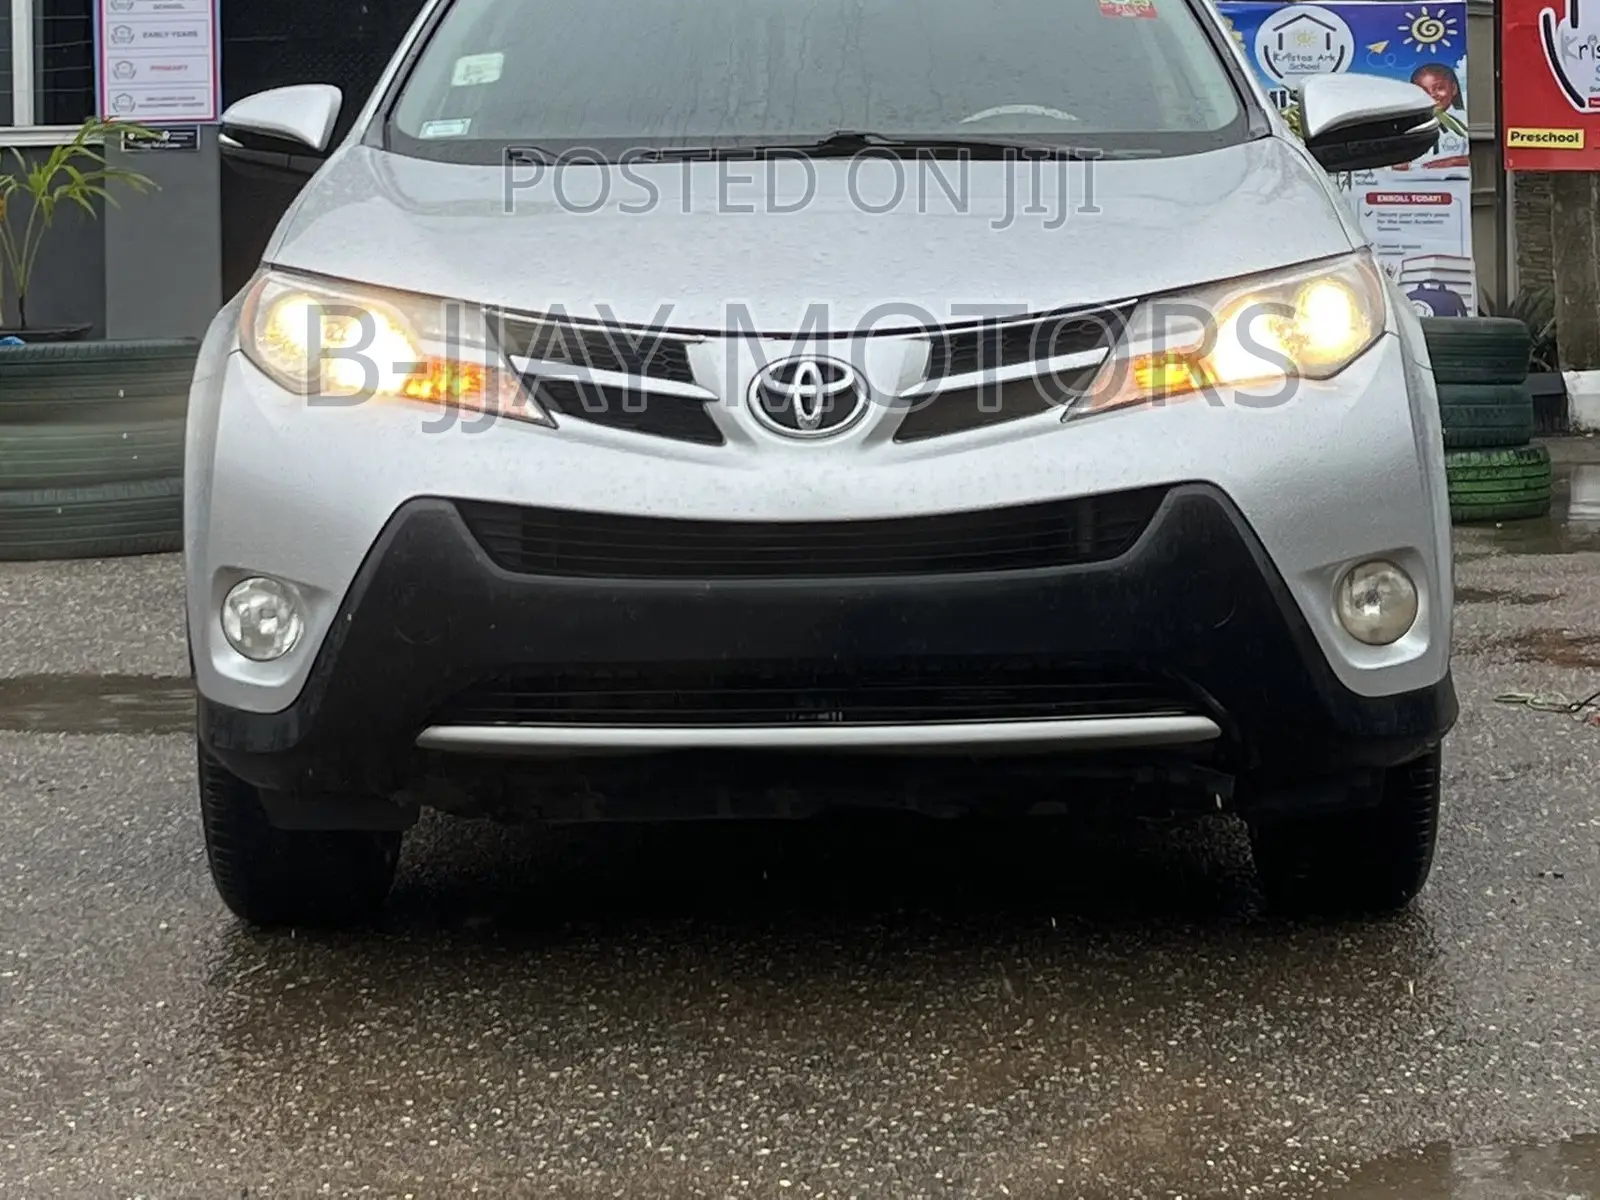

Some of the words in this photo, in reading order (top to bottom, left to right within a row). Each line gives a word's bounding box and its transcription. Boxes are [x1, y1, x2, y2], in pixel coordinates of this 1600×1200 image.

[142, 31, 169, 39] EARLY
[1318, 53, 1336, 62] Ark
[1288, 63, 1320, 71] School
[1510, 131, 1579, 145] Preschool
[1377, 194, 1410, 203] ENROLL
